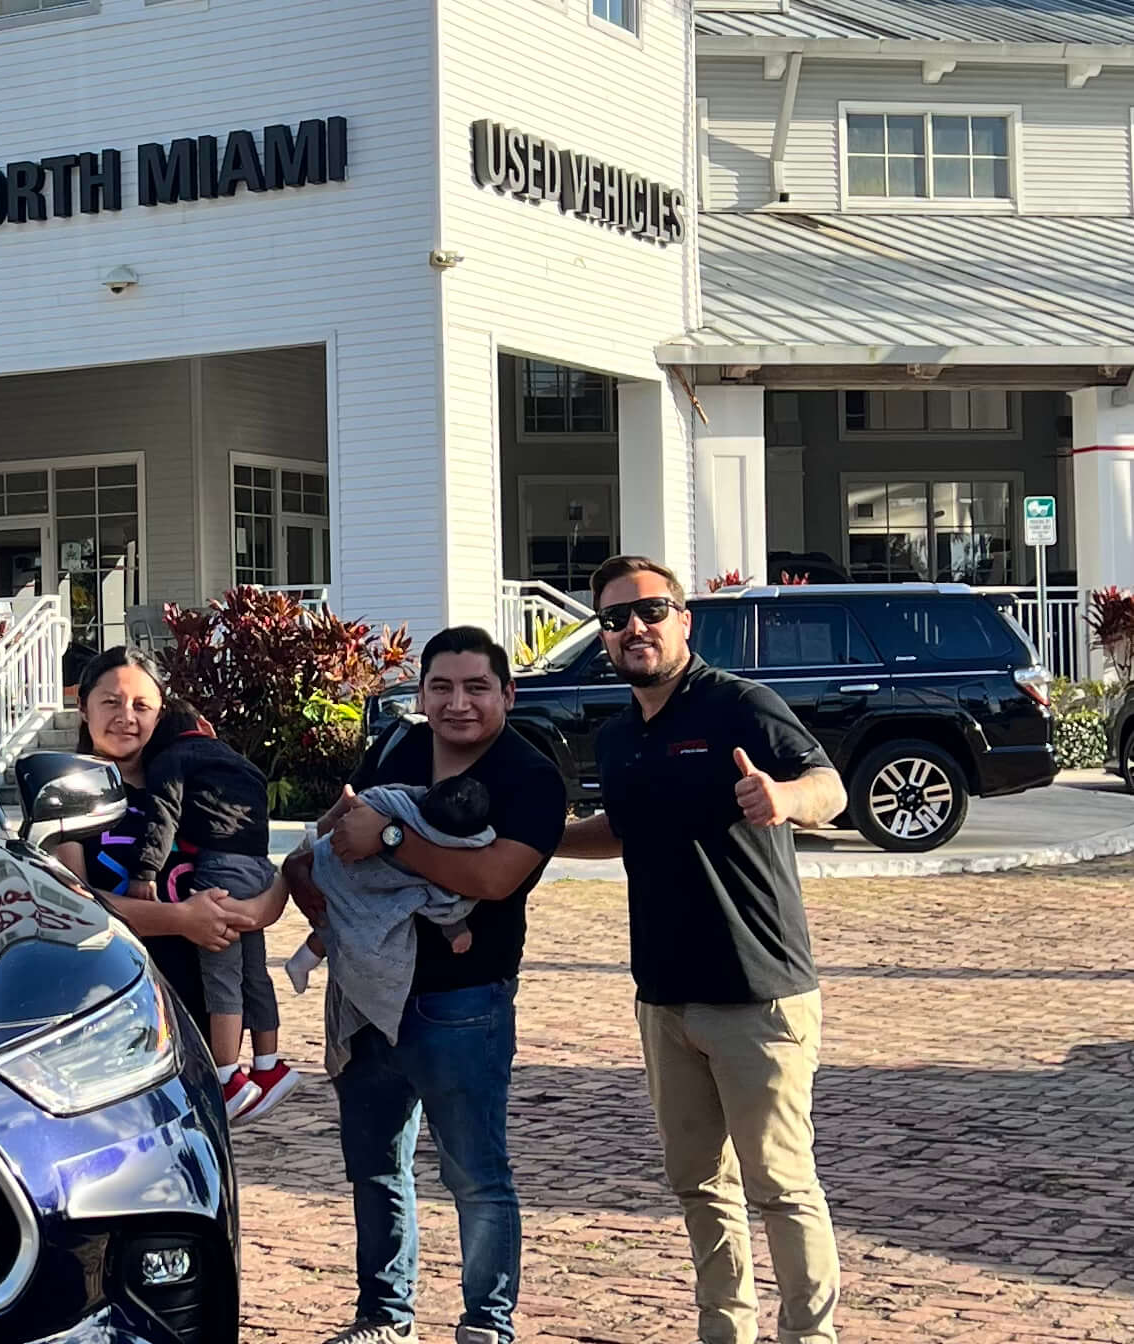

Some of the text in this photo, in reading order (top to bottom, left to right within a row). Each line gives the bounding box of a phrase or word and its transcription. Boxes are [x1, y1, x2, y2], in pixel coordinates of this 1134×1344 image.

[137, 115, 349, 208] MIAMI
[469, 119, 686, 246] USED VEHICLES
